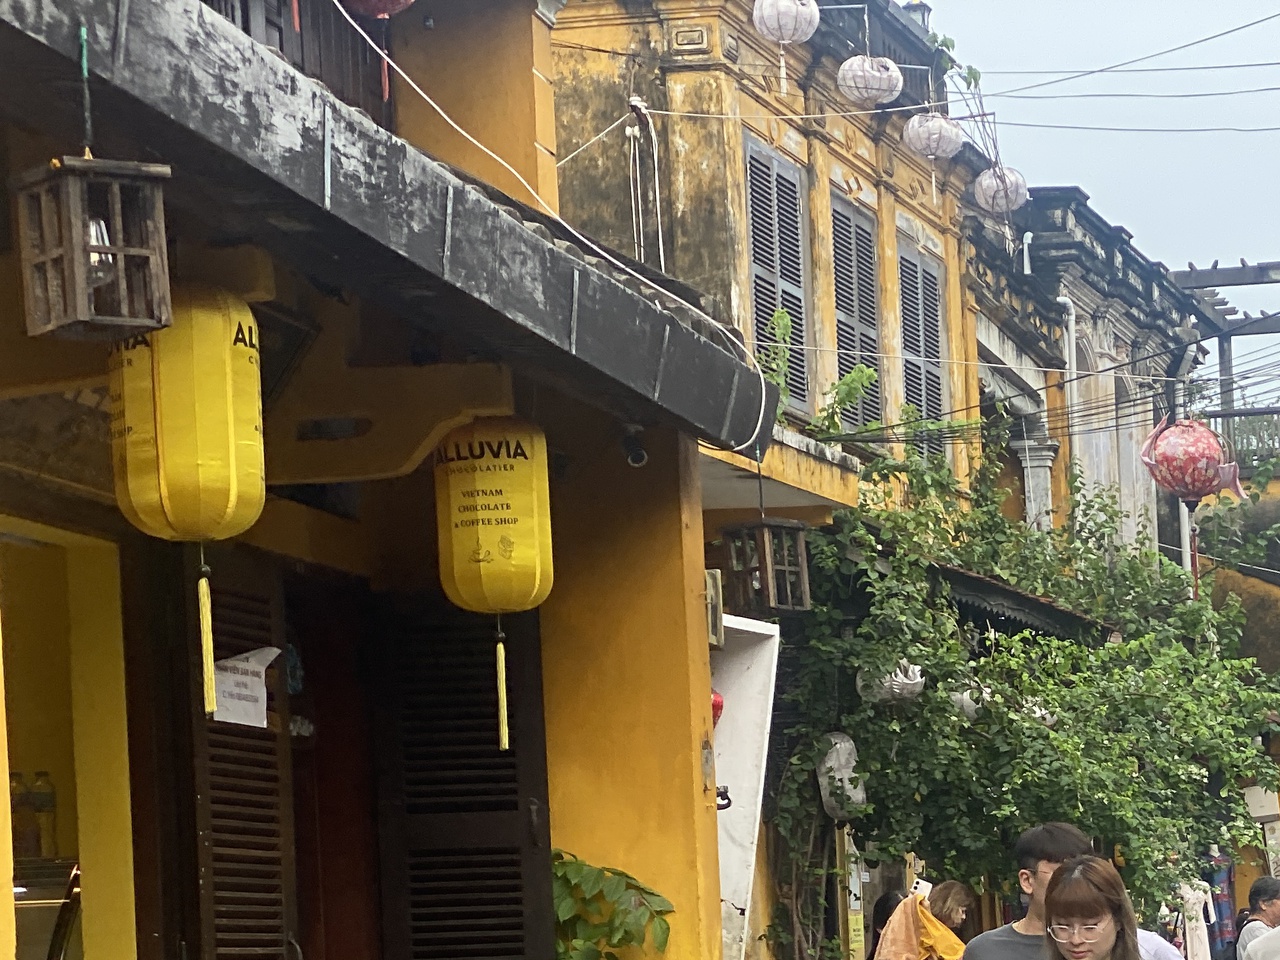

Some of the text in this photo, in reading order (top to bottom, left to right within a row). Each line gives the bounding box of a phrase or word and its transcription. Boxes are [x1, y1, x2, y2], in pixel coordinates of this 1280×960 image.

[436, 439, 529, 465] ALLUVIA
[461, 488, 503, 498] VIETNAM
[458, 503, 511, 513] CHOCOLATE
[460, 518, 493, 528] COFFEE
[494, 517, 519, 526] SHOP
